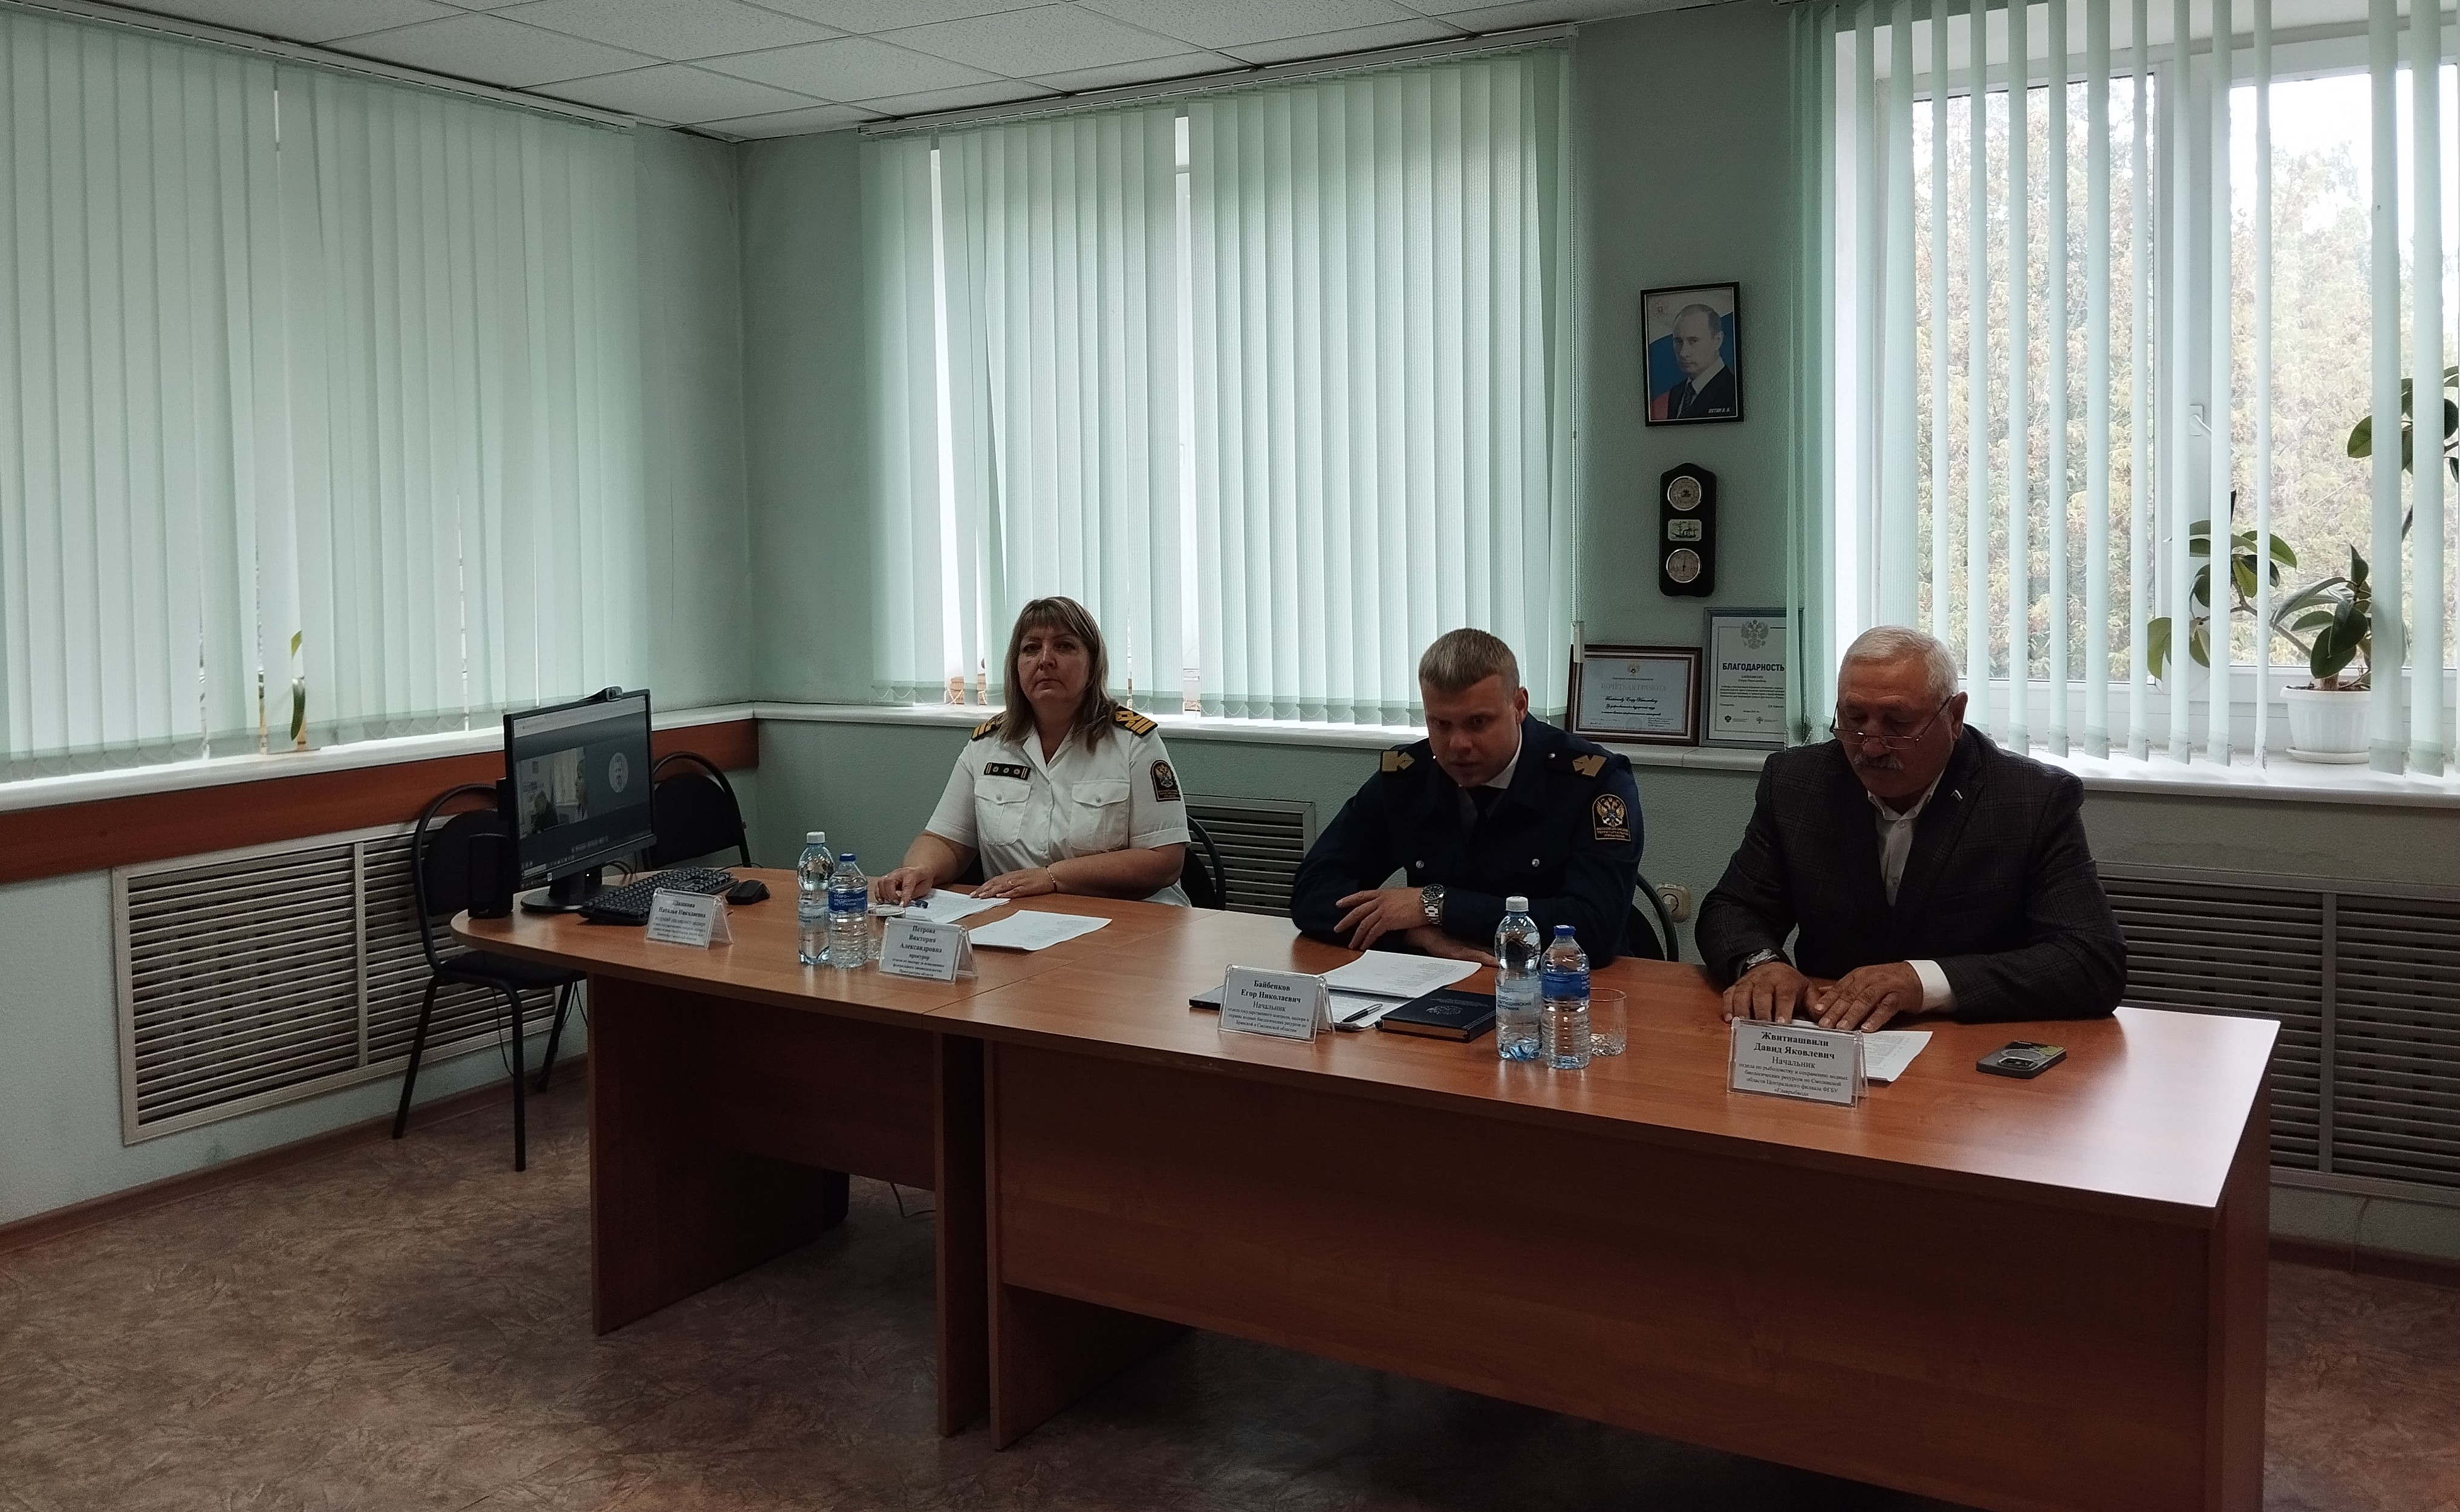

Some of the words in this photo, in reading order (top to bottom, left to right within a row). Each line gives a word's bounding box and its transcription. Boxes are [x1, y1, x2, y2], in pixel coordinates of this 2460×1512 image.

[1722, 663, 1785, 671] БЛАГОДАРНОСТЬ
[913, 925, 936, 933] Петрова
[909, 934, 936, 943] Виктория
[900, 943, 942, 953] Александровна
[1254, 981, 1290, 990] Байбенков
[1241, 989, 1257, 998] Егор
[1259, 991, 1301, 1002] Николаевич
[1253, 1002, 1286, 1011] Начальник
[1762, 1031, 1828, 1046] Жвитиашвили
[1754, 1042, 1782, 1053] Давид
[1785, 1046, 1834, 1059] Яковлевич
[1772, 1057, 1815, 1068] Начальник
